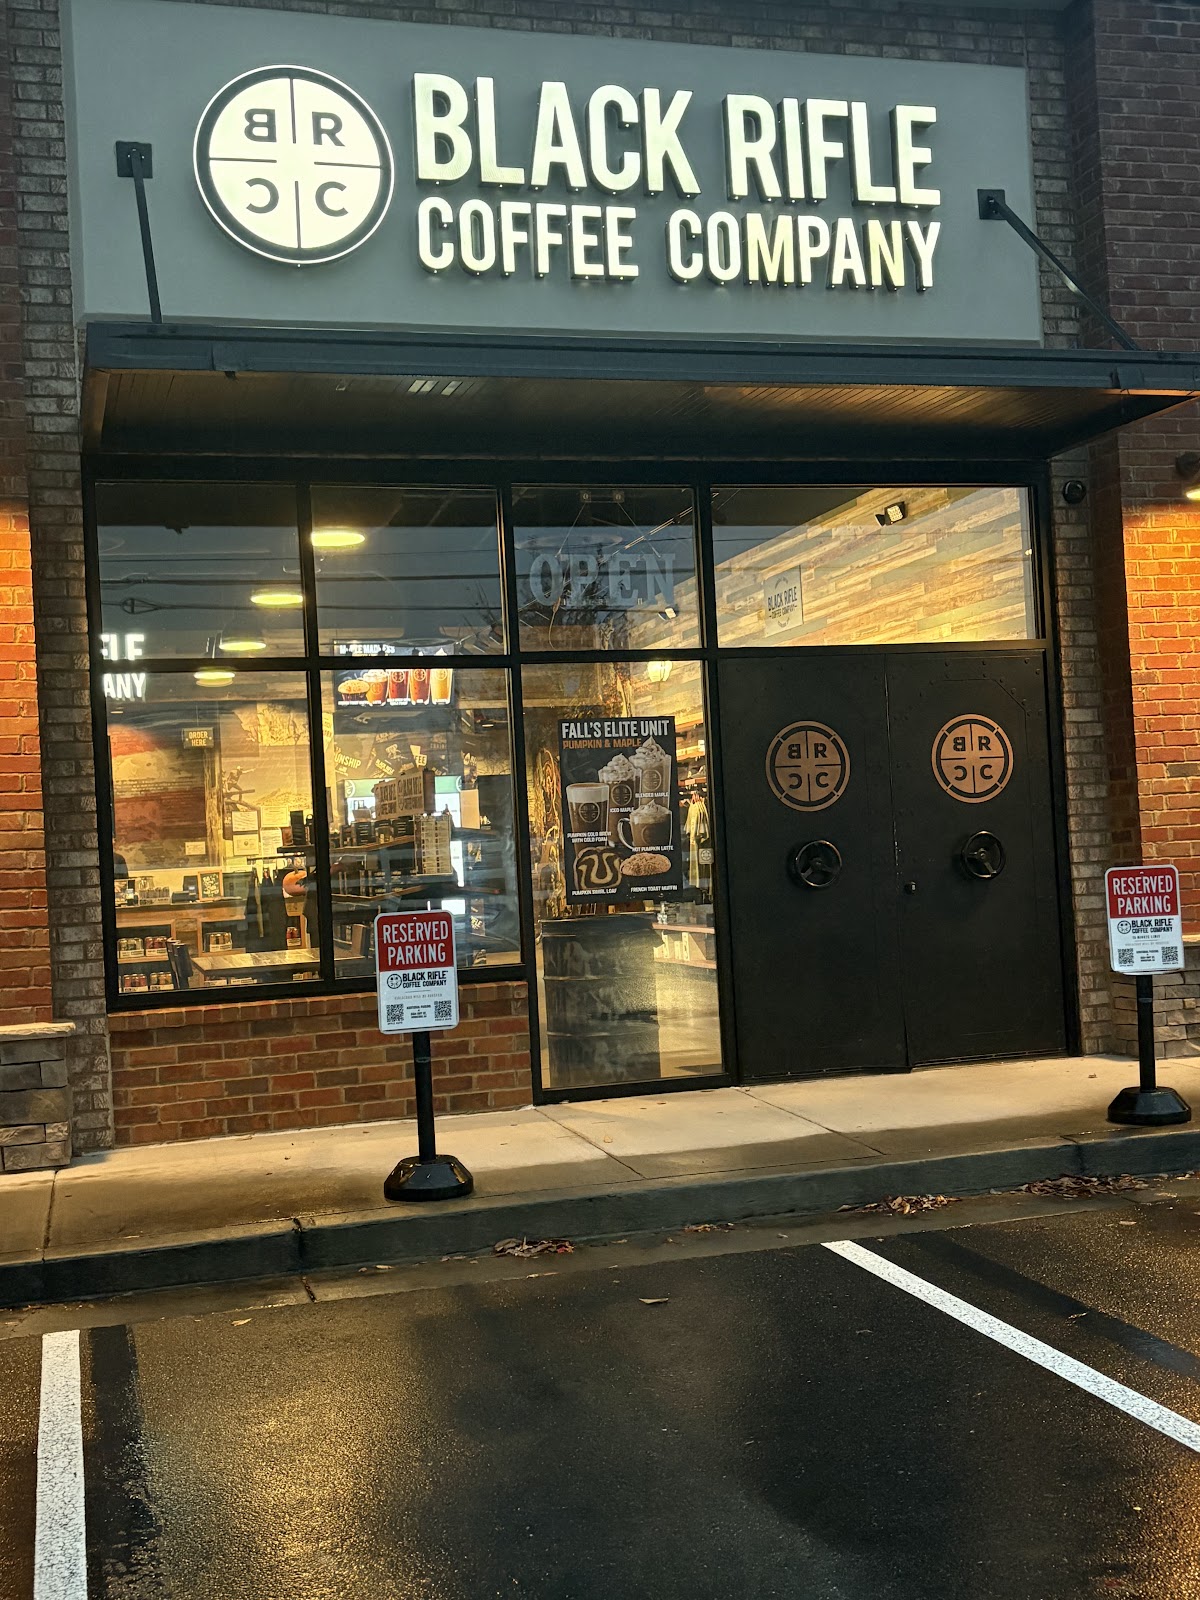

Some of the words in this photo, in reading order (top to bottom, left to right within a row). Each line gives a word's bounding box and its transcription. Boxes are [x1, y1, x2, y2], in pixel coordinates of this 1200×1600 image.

[412, 72, 700, 195] BLACK
[723, 92, 942, 208] RIFLE
[417, 195, 640, 280] COFFEE
[667, 209, 942, 292] COMPANY
[529, 553, 676, 607] OPEN
[189, 731, 208, 739] ORDER
[561, 722, 602, 739] FALL'S
[604, 721, 639, 738] ELITE
[640, 720, 670, 737] UNIT
[191, 739, 207, 747] HERE
[562, 740, 602, 750] PUMPKIN
[604, 740, 611, 748] &
[613, 738, 642, 748] MAPLE
[1112, 875, 1173, 895] RESERVED
[1117, 895, 1171, 915] PARKING
[382, 920, 449, 944] RESERVED
[1131, 919, 1153, 928] BLACK
[1154, 918, 1172, 927] RIFLE
[387, 943, 446, 966] PARKING
[402, 972, 426, 982] BLACK
[427, 971, 447, 980] RIFLE
[402, 981, 421, 989] COFFEE
[422, 980, 447, 988] COMPANY
